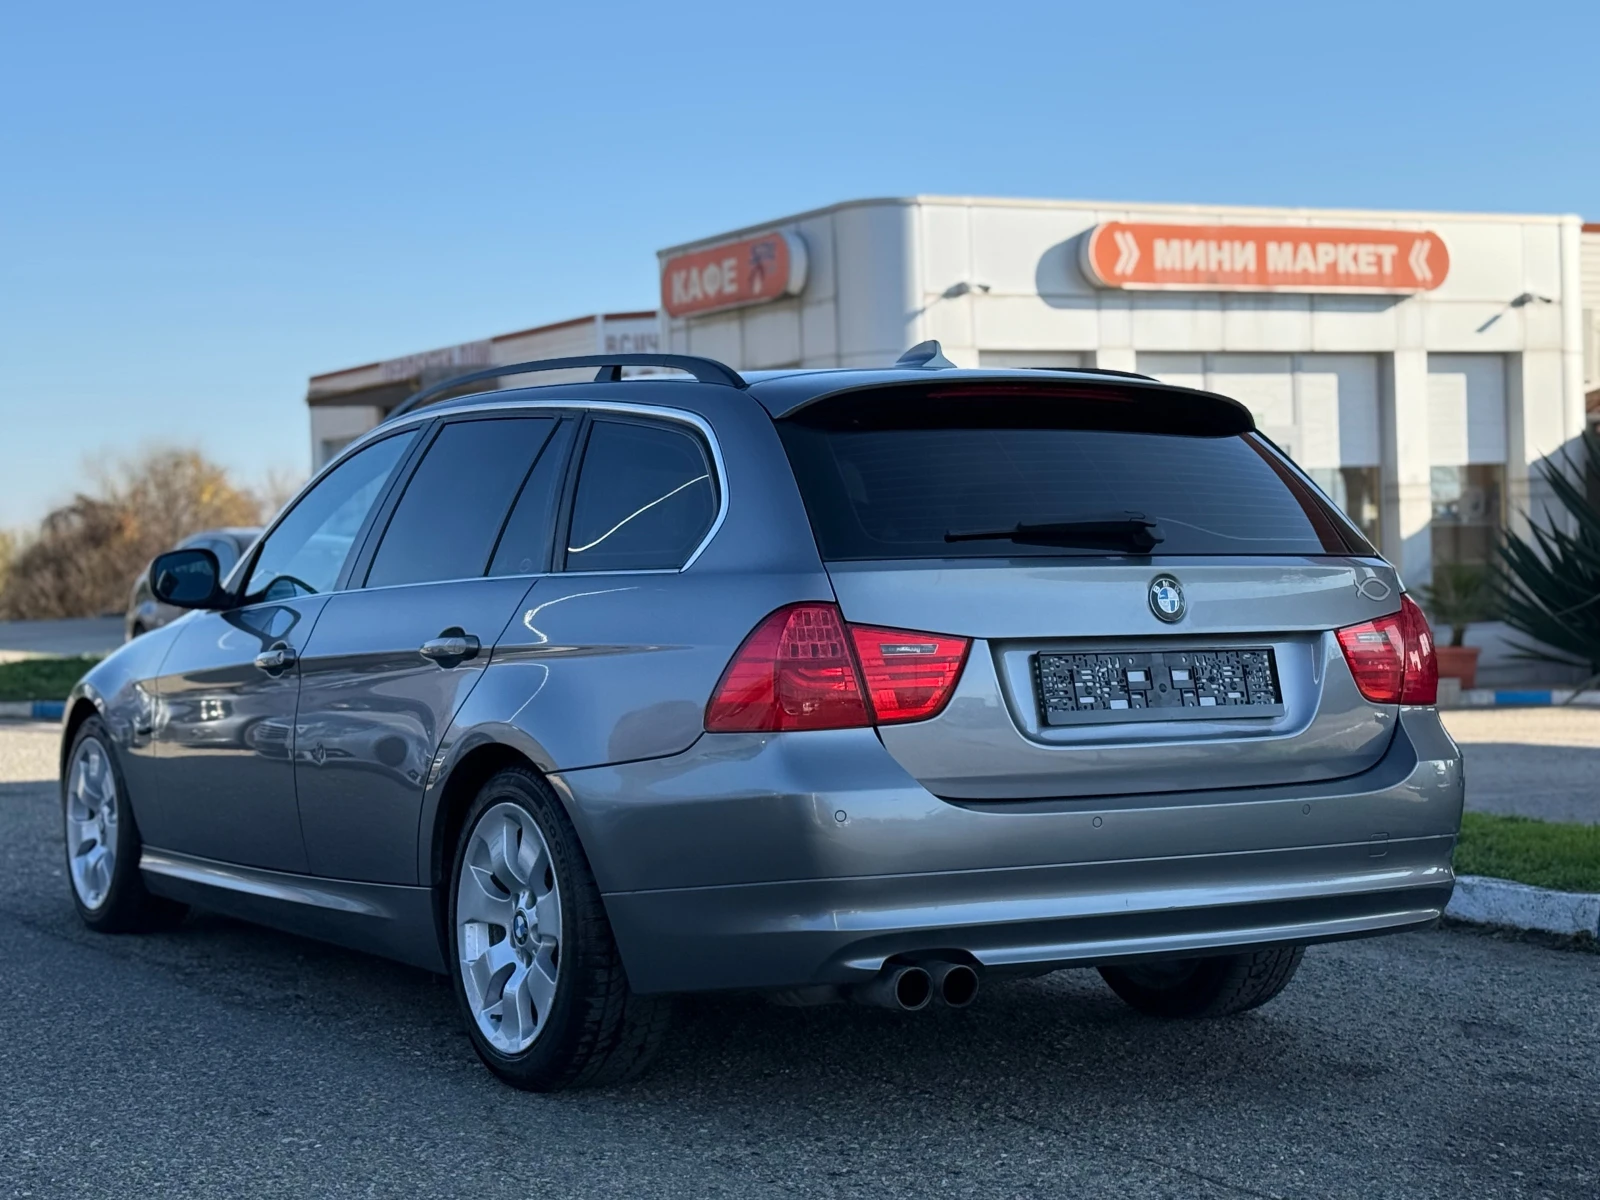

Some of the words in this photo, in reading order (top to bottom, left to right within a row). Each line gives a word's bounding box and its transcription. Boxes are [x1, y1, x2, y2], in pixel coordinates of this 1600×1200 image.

[1152, 239, 1256, 272] МИНИ
[1266, 241, 1398, 275] МАРКЕТ
[671, 258, 737, 304] КАФЕ
